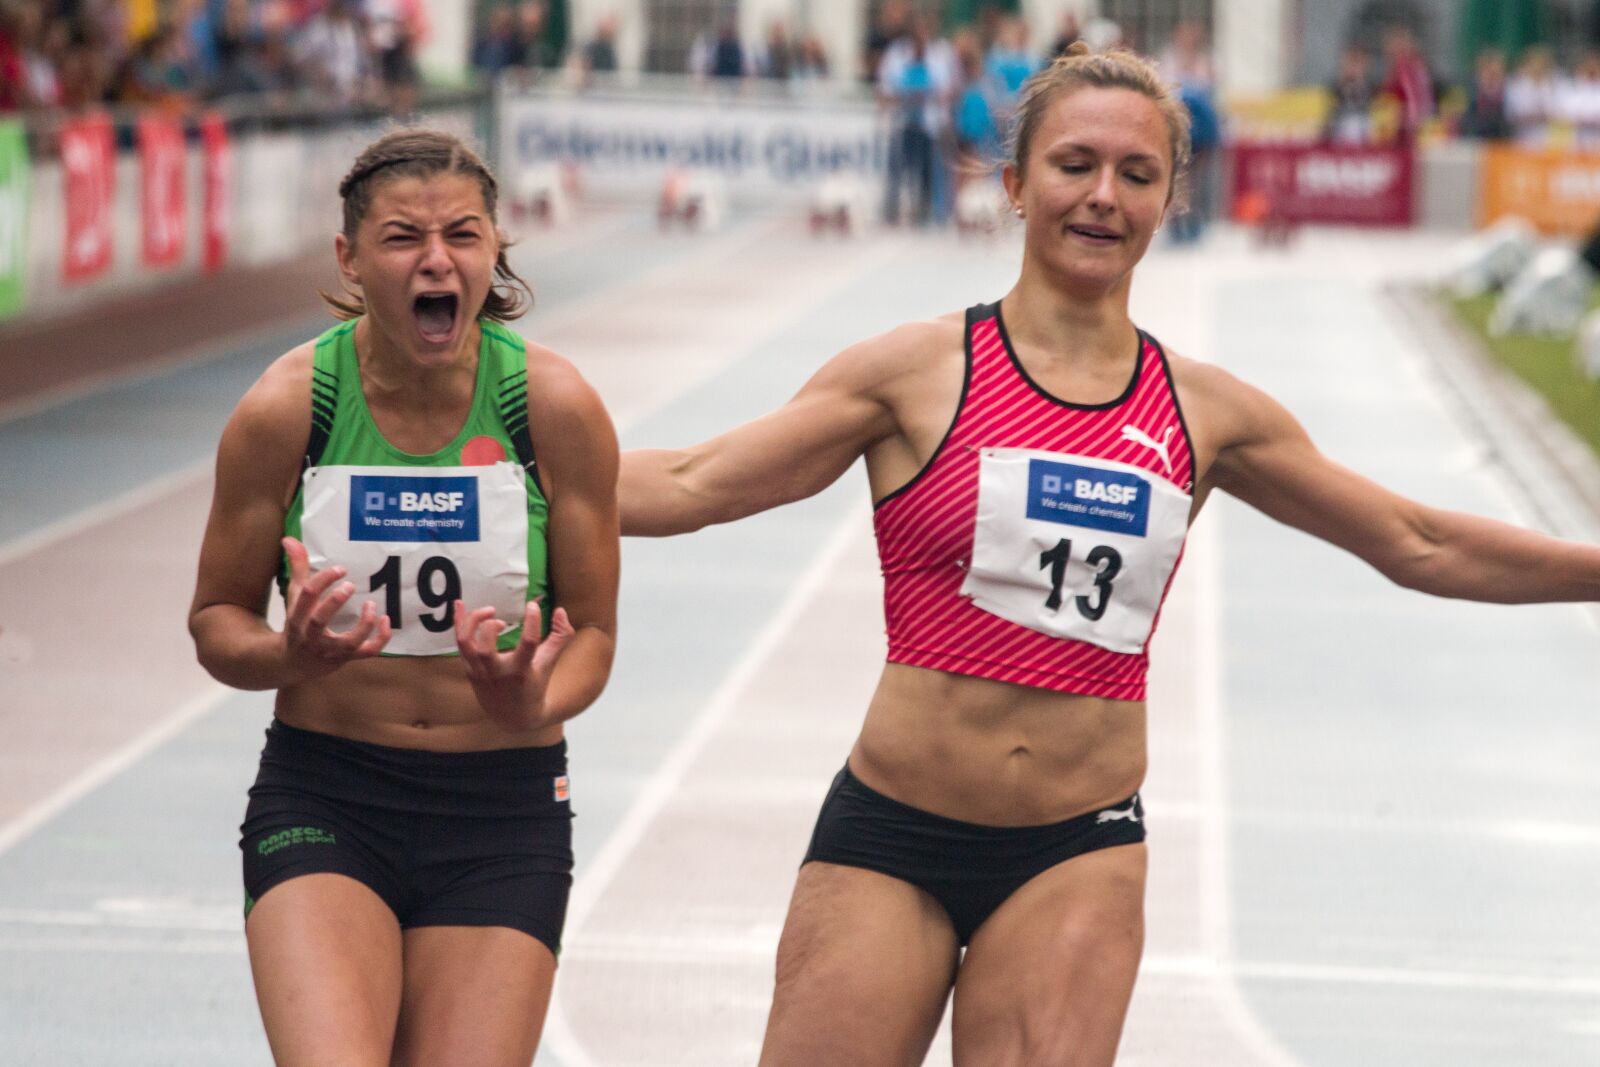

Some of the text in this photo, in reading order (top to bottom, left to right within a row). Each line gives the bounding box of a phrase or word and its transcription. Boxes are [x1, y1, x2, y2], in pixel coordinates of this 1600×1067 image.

[400, 491, 465, 512] BASF
[1074, 478, 1138, 505] BASF
[364, 516, 465, 529] We create chemistry
[1041, 497, 1136, 523] We create chemistry
[1040, 538, 1122, 621] 13
[369, 555, 462, 633] 19
